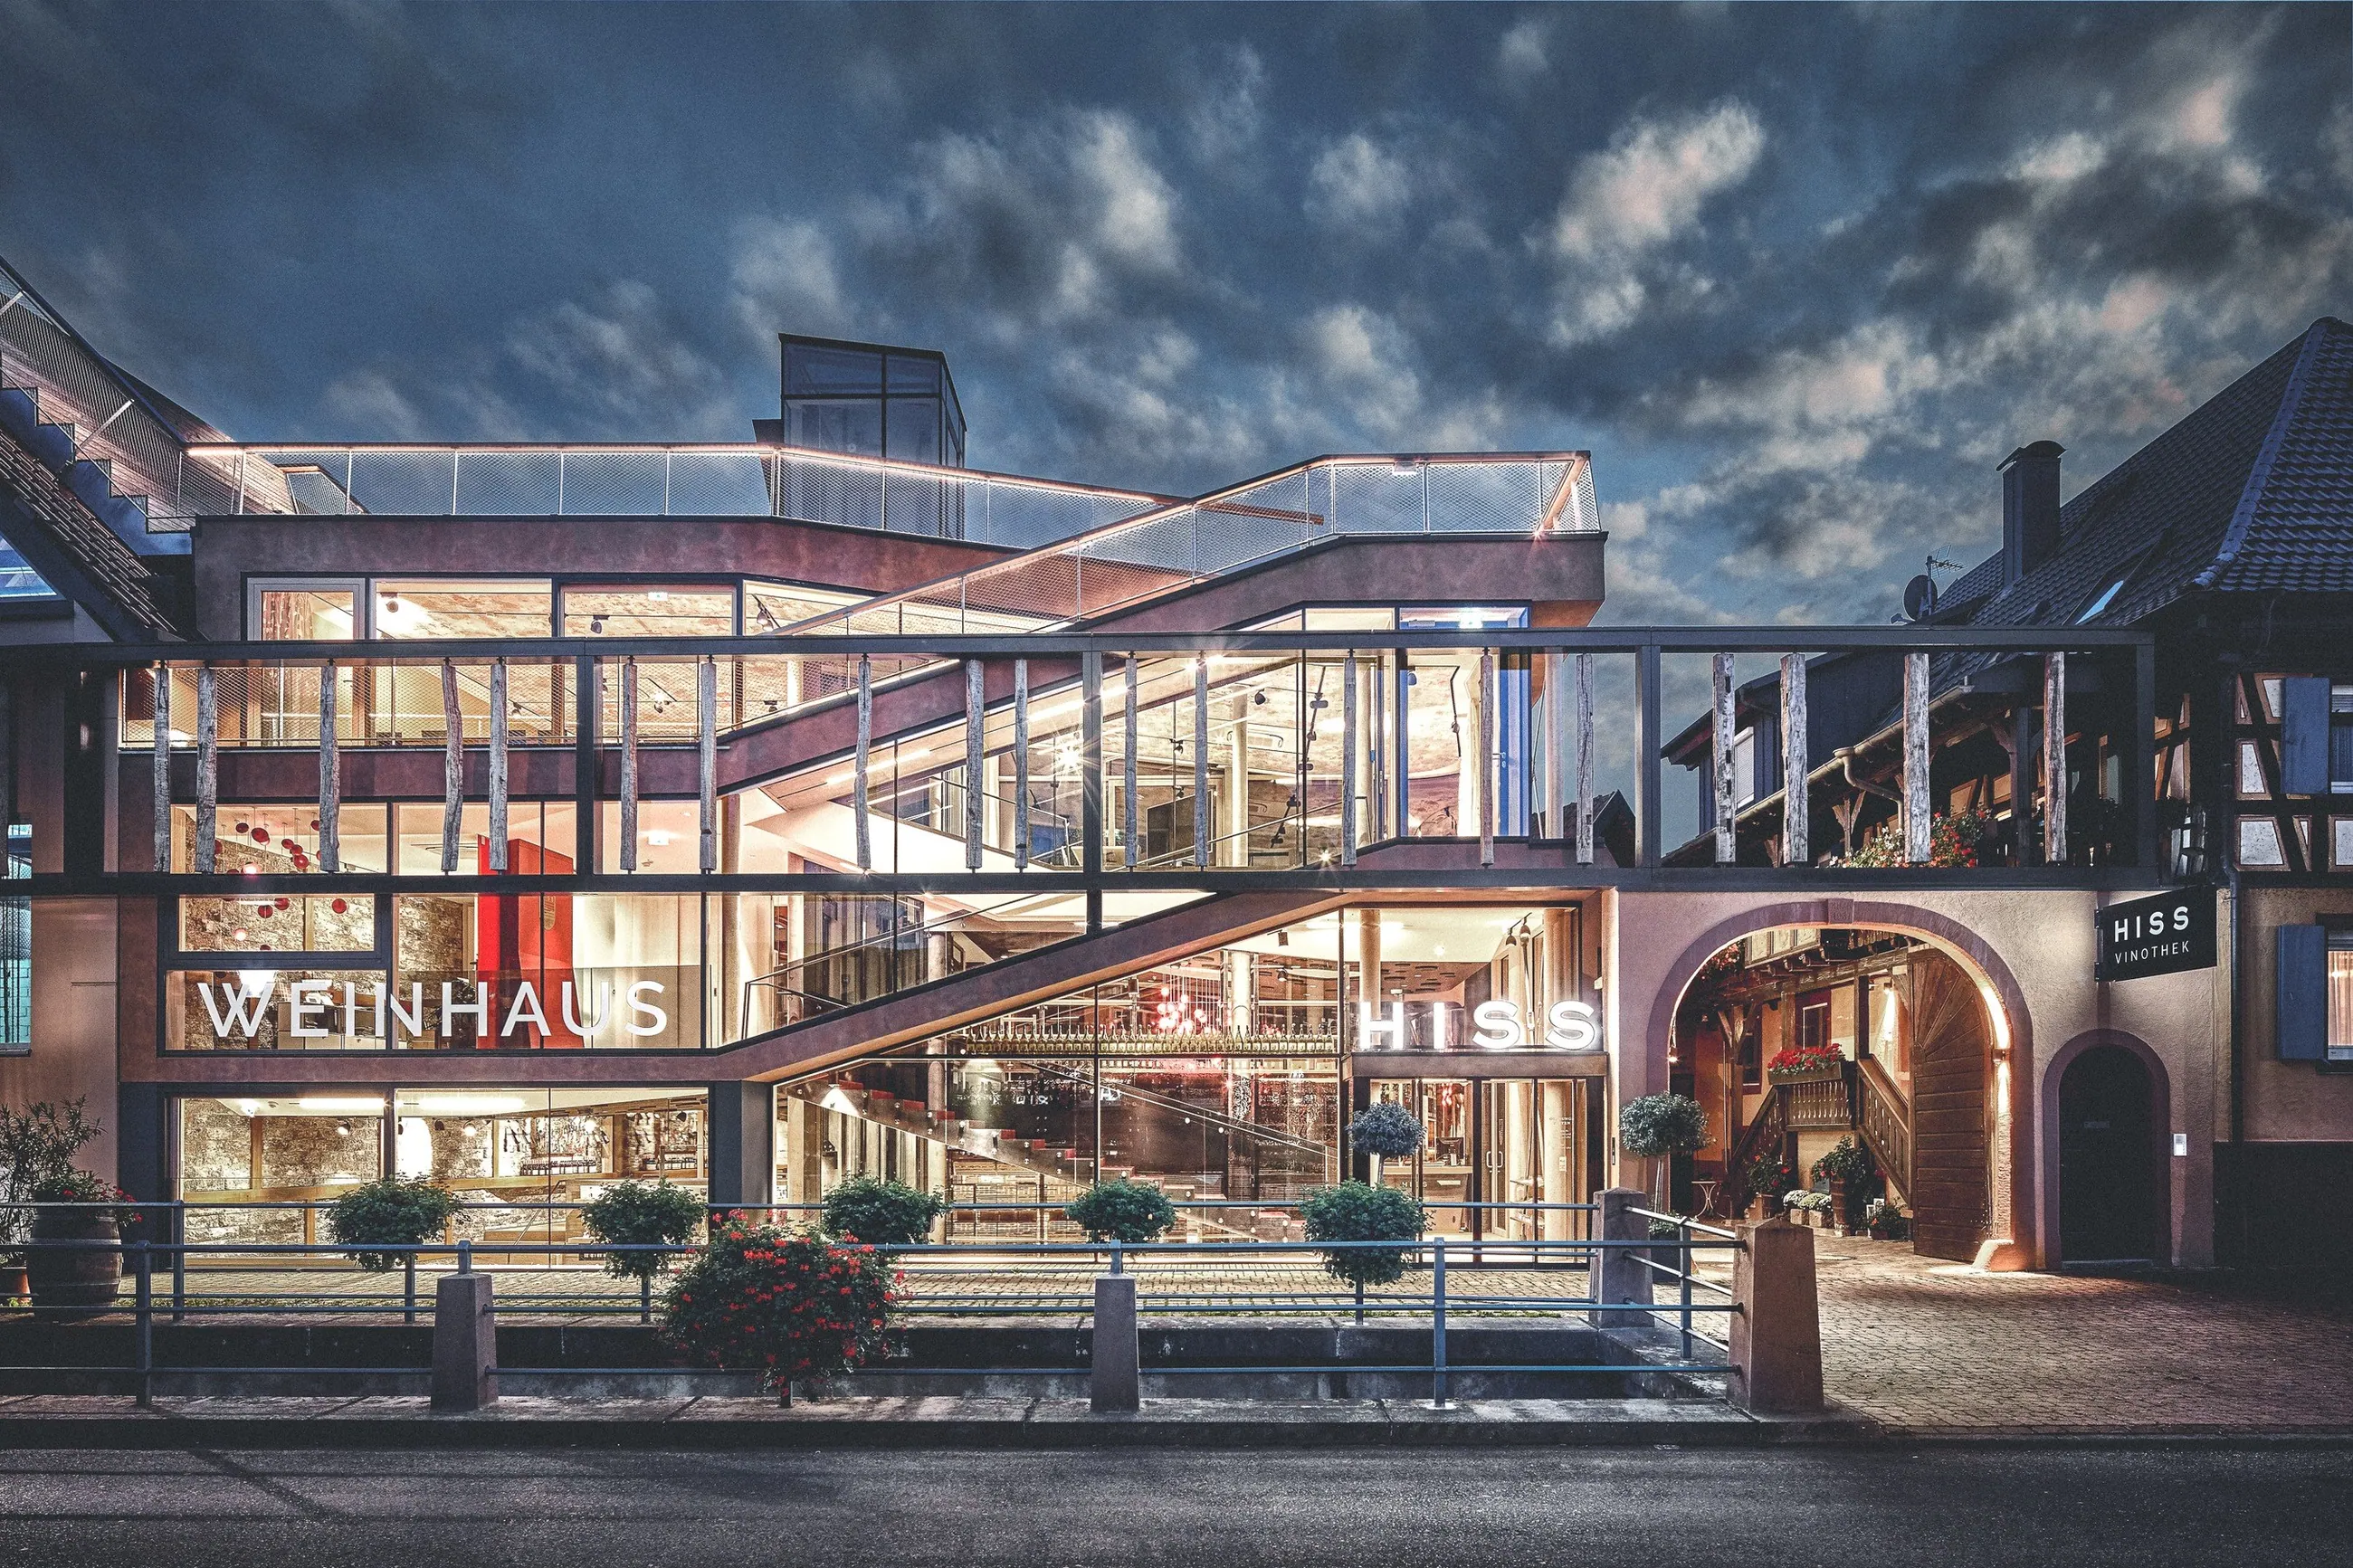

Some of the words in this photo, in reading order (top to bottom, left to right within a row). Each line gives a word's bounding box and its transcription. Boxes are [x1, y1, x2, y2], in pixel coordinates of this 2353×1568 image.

[2114, 906, 2189, 943] HISS
[2114, 940, 2190, 965] VINOTHEK
[196, 980, 668, 1038] WEINHAUS
[1359, 999, 1596, 1050] HISS
